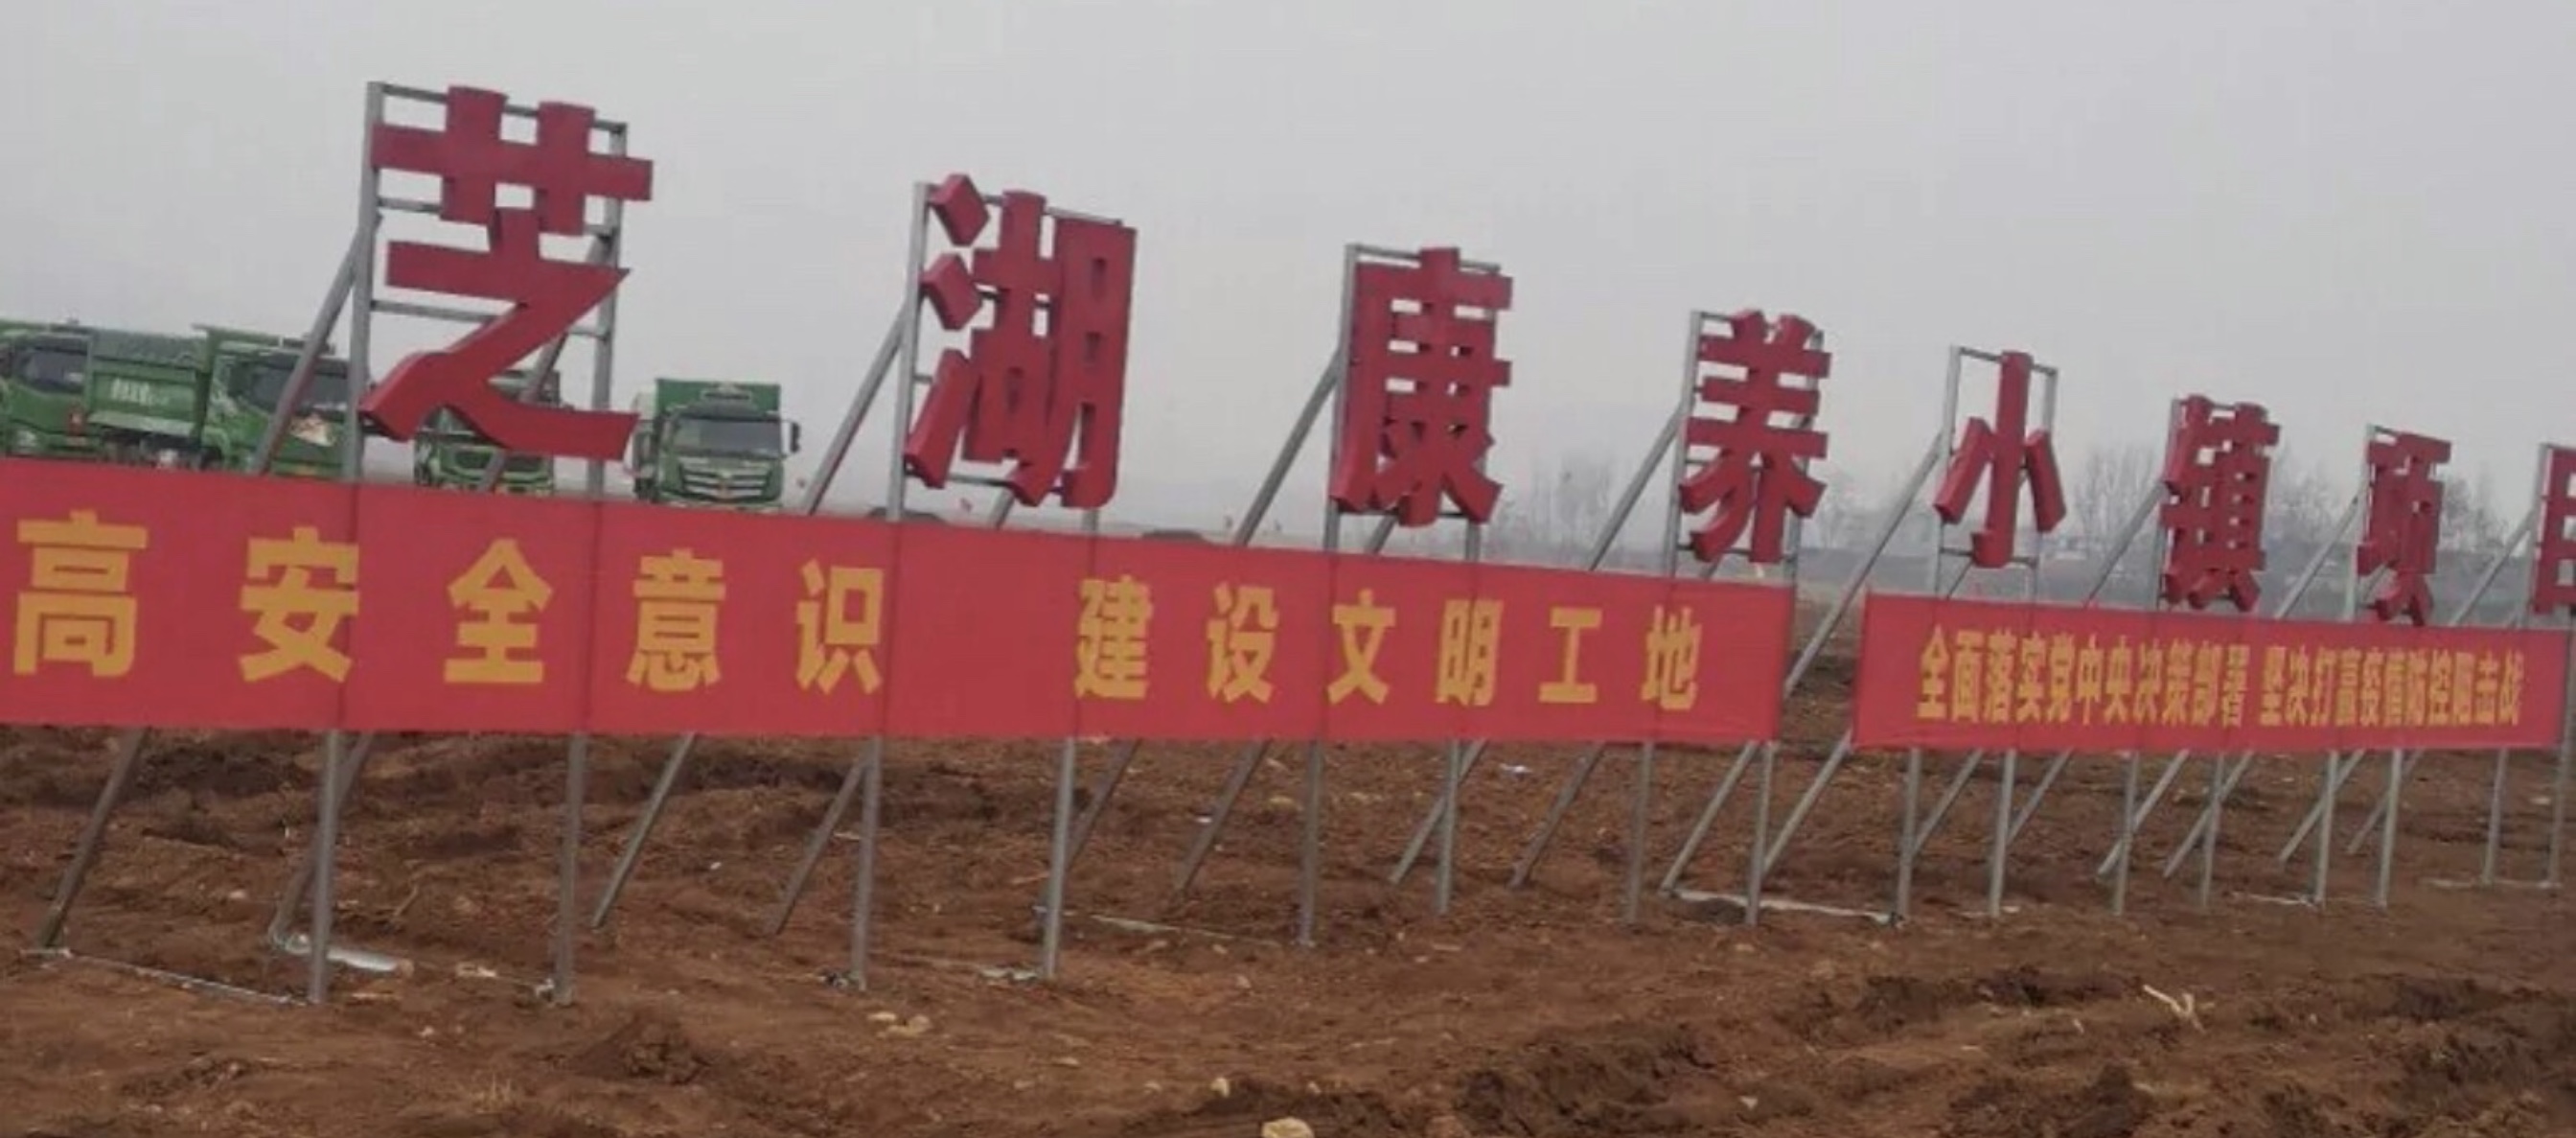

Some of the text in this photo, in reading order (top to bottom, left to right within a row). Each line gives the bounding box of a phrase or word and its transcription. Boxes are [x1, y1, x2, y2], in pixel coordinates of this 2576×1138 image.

[12, 510, 1700, 710] 高安全意识 建设文明工地
[1917, 624, 2251, 727] 全面落实党中央决策部署
